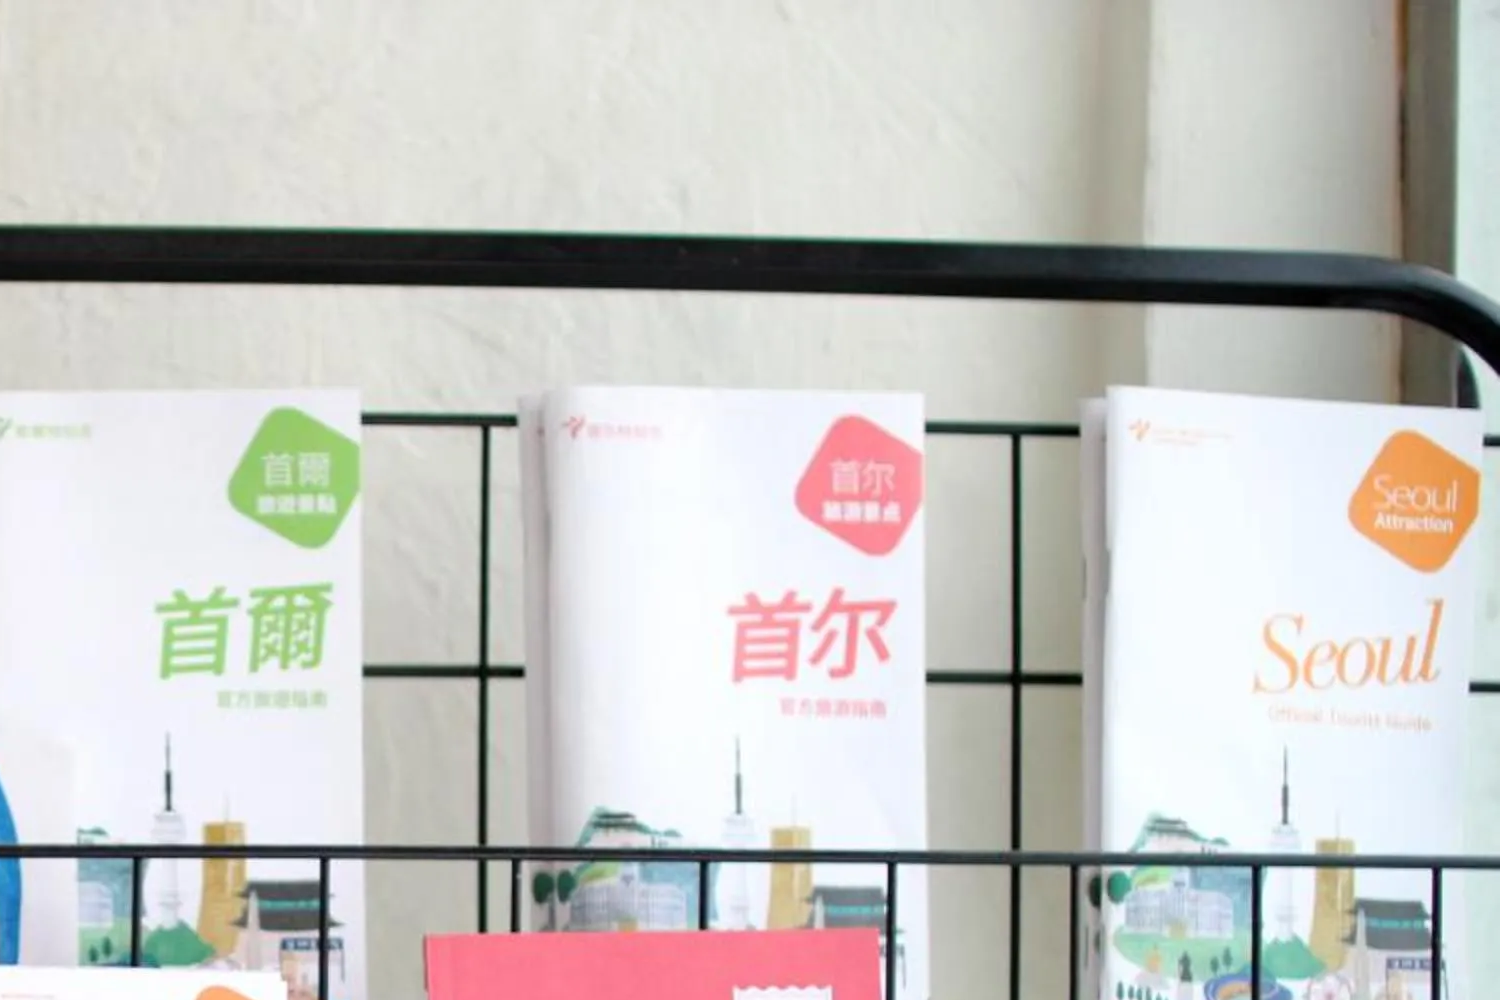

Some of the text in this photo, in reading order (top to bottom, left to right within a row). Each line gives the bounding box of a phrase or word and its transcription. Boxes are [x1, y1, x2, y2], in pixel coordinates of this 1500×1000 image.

[261, 452, 332, 488] 首爾
[830, 460, 896, 495] 首尔
[1373, 474, 1458, 512] Seoul
[1374, 513, 1454, 533] Attraction
[155, 583, 334, 680] 首爾
[727, 587, 897, 682] 首尔
[1252, 597, 1445, 694] Seoul
[1268, 704, 1323, 722] Official
